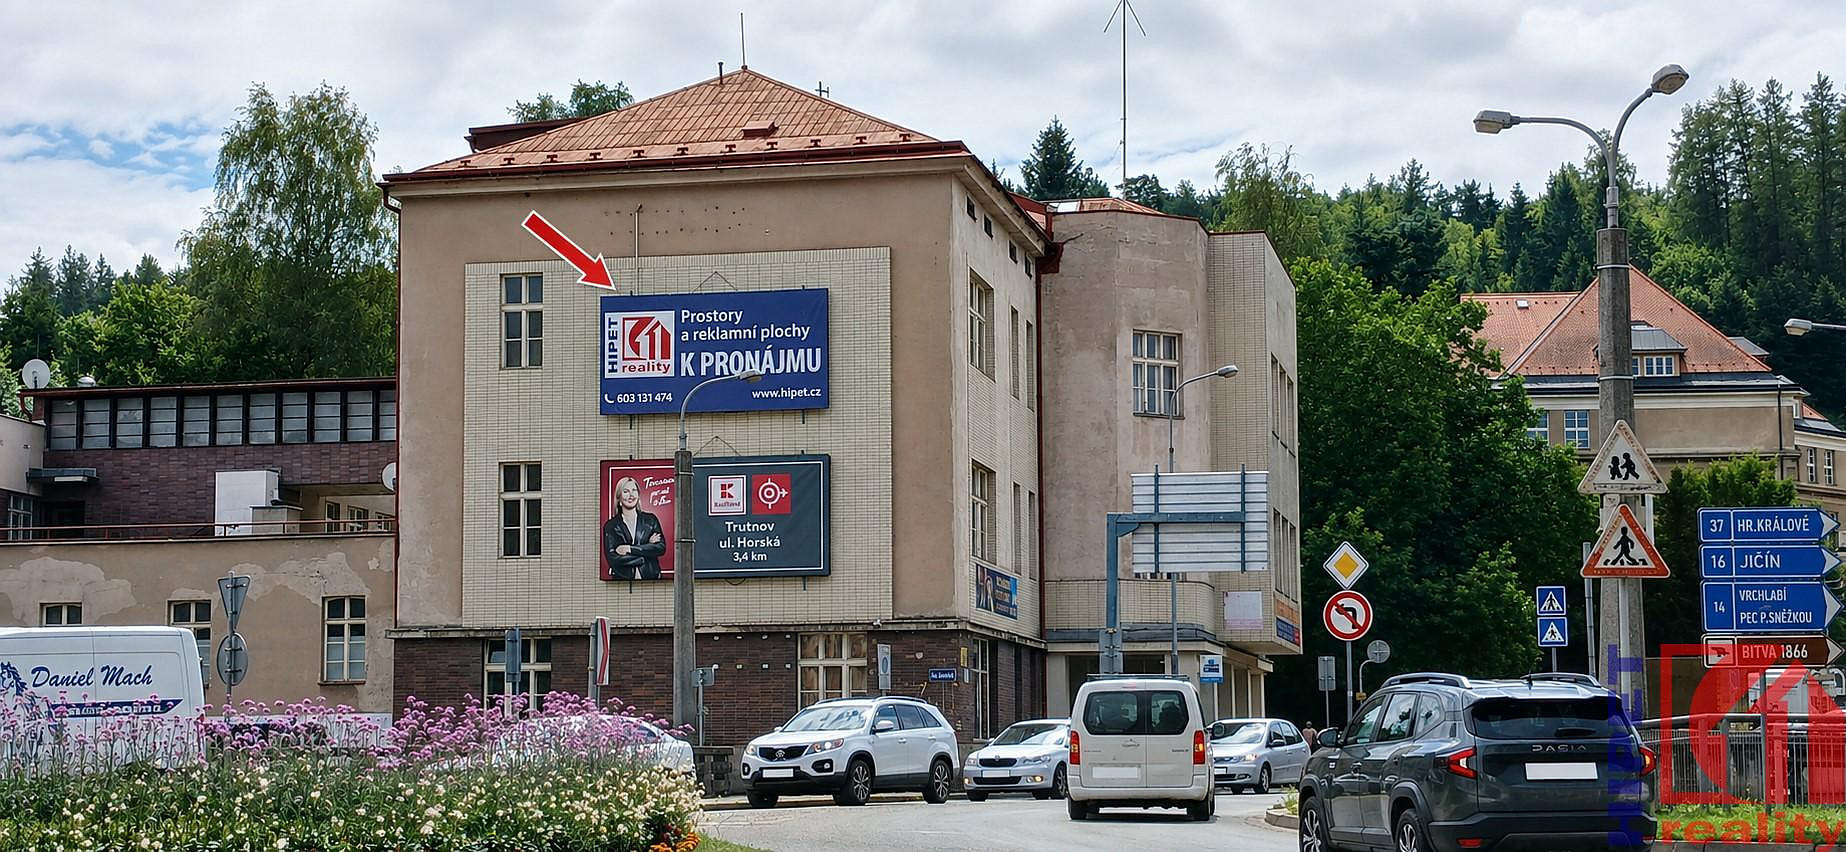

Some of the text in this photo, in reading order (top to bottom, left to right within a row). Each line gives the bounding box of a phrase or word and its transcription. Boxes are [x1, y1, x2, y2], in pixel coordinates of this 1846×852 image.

[681, 310, 743, 324] Prostory
[681, 323, 810, 342] a reklamní plochy
[608, 317, 618, 373] HIPET
[622, 362, 671, 374] reality
[680, 345, 822, 377] K PRONÁJMU
[617, 392, 673, 403] 603 131 474
[752, 387, 821, 399] www.hipet.cz
[720, 482, 734, 498] K
[725, 521, 775, 532] Trutnov
[1710, 519, 1723, 532] 37
[1738, 514, 1809, 532] HR.KRÁLOVÉ
[719, 536, 781, 549] ul. Horská
[733, 551, 767, 562] 3,4 km
[1711, 554, 1726, 568] 16
[1740, 550, 1780, 568] JIČÍN
[1739, 587, 1787, 601] VRCHLABÍ
[1714, 601, 1726, 613] 14
[1740, 609, 1812, 624] PEC P.SNĚŽKOU
[1742, 644, 1808, 658] BITVA 1866
[31, 664, 153, 687] Daniel Mach
